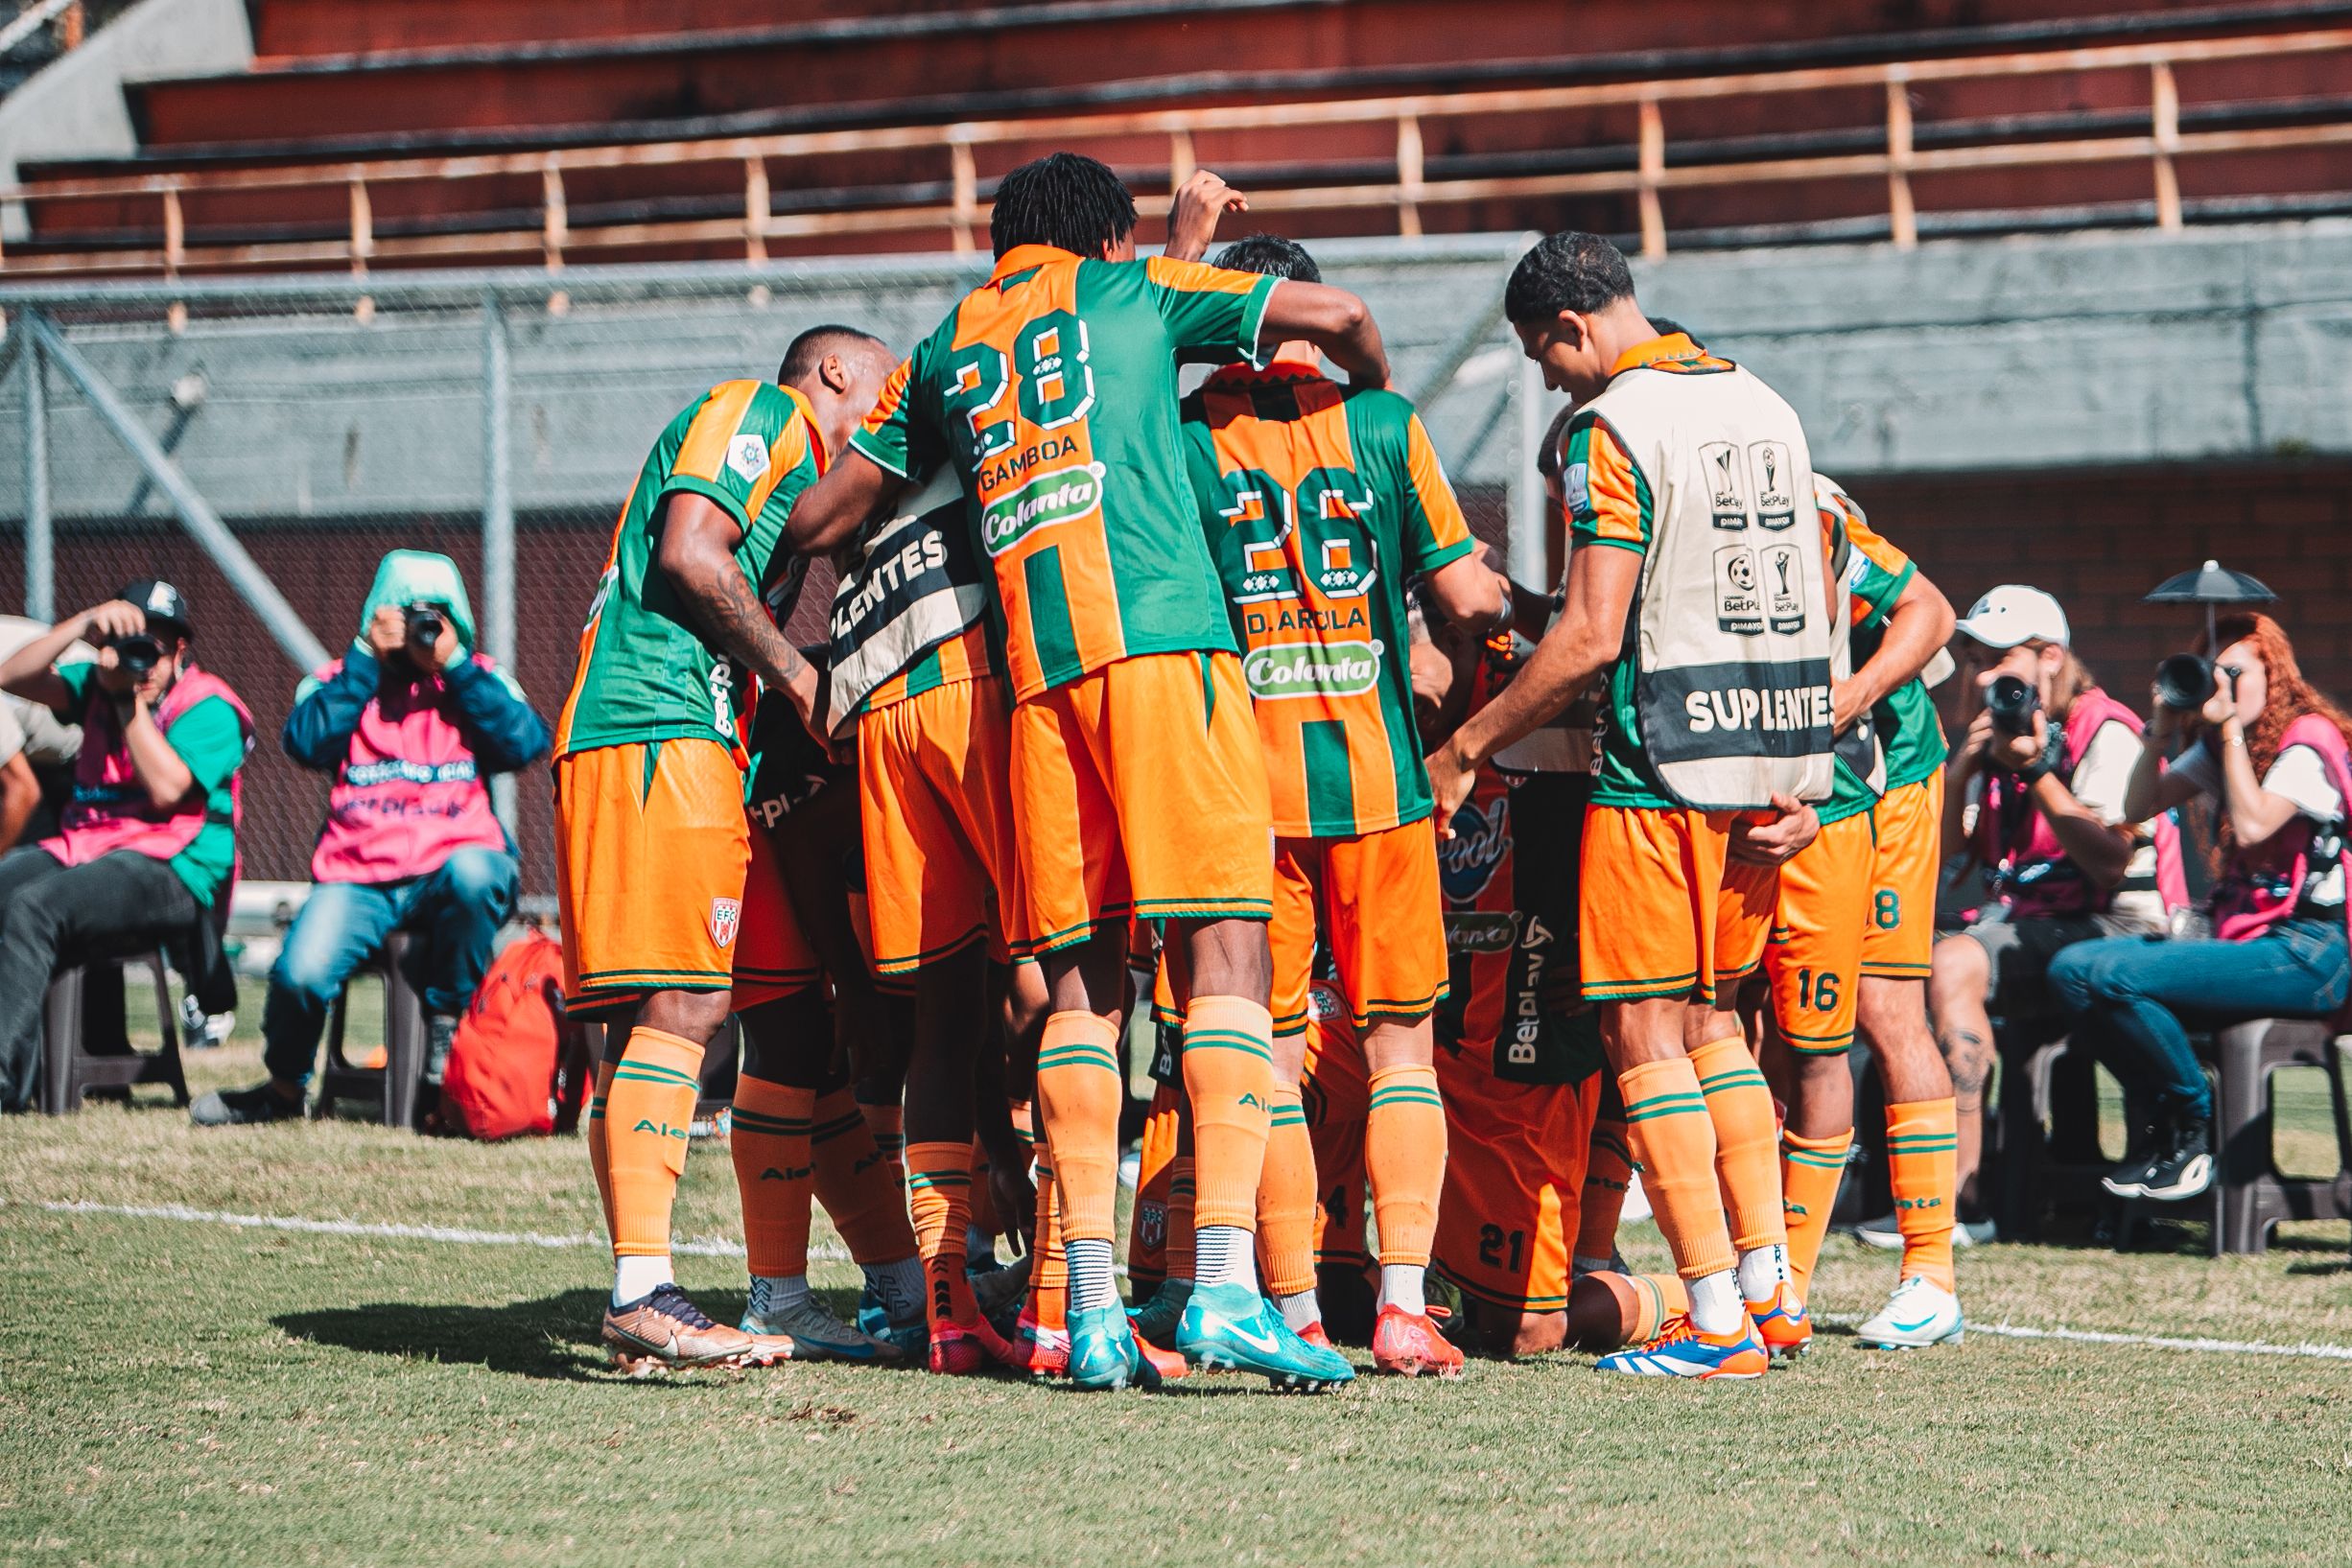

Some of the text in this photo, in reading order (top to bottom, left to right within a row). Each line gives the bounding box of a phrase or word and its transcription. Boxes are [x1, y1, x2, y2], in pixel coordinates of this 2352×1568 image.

[944, 308, 1096, 472] 28
[979, 435, 1079, 492] GAMBOA
[984, 481, 1094, 539] Colanta
[1218, 467, 1378, 604] 26
[1247, 613, 1274, 635] D.
[1248, 656, 1374, 686] Colanta
[717, 909, 736, 923] EFC
[1799, 969, 1840, 1012] 16
[1479, 1222, 1525, 1275] 21
